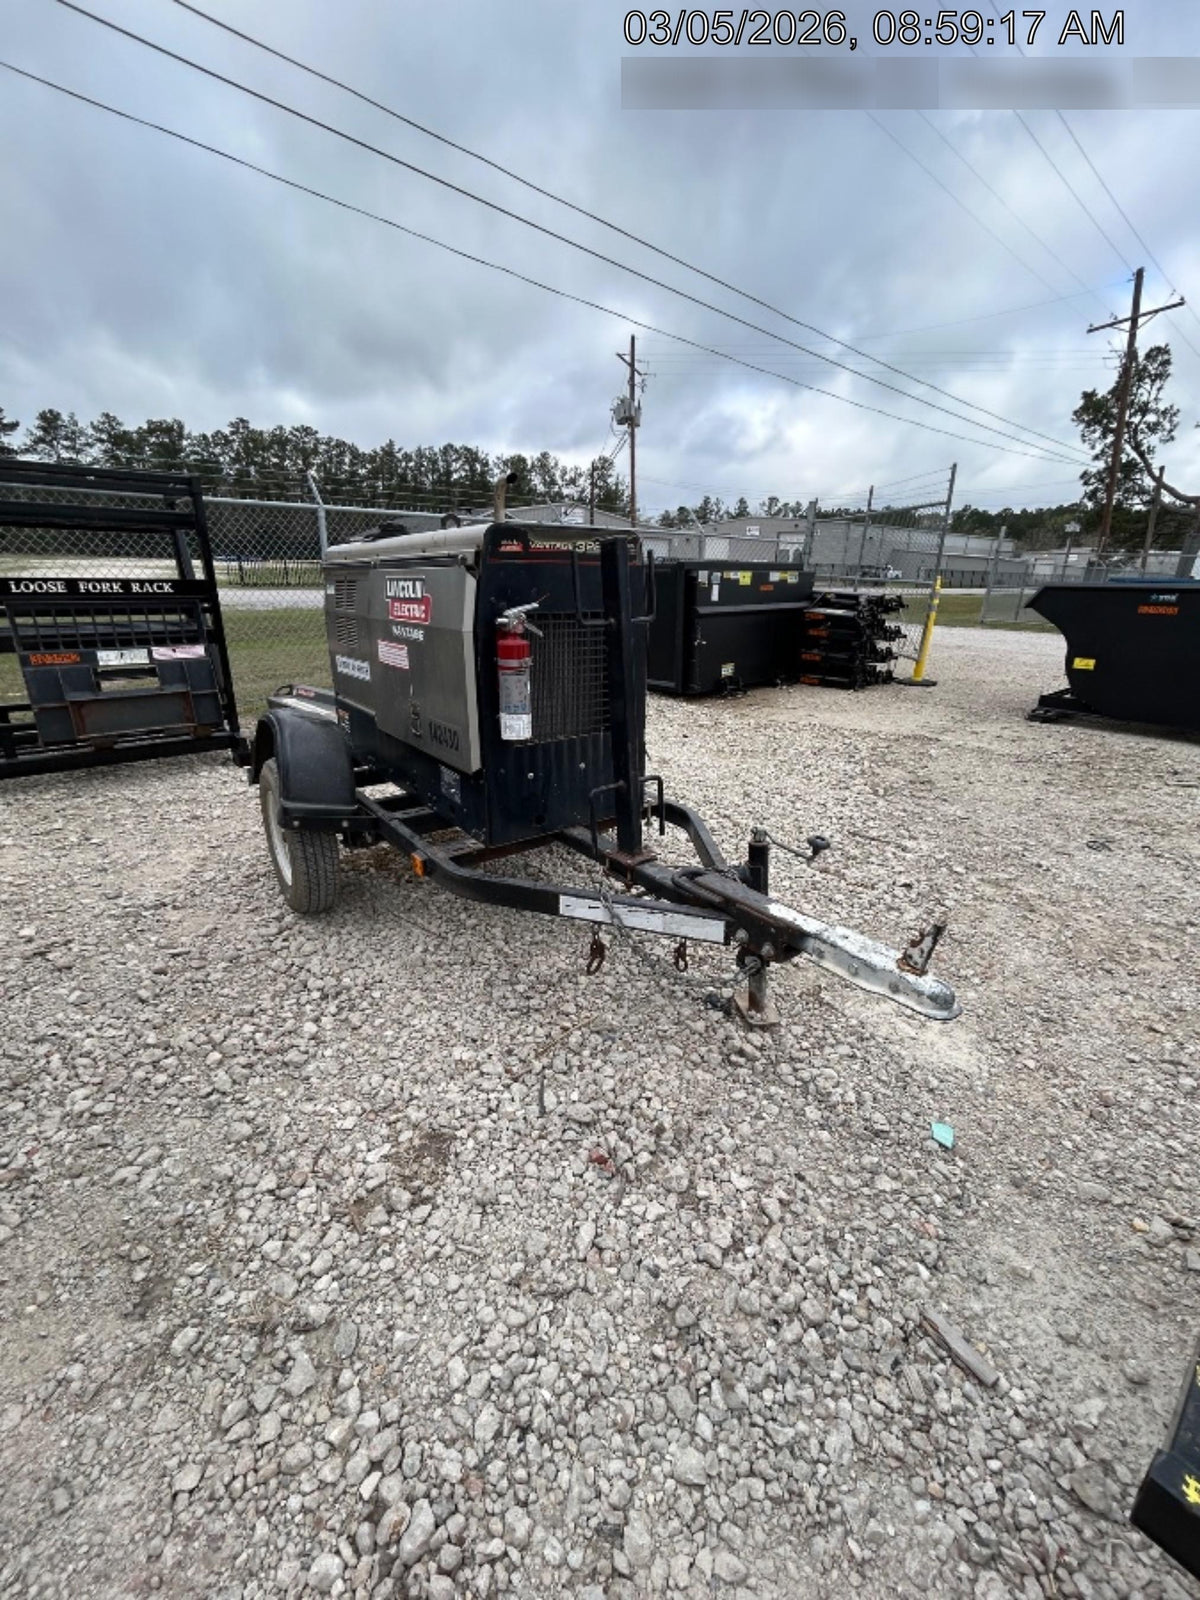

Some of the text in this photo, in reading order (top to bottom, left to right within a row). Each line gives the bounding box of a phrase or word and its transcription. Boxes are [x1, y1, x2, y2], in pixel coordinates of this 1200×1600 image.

[9, 581, 175, 593] LOOSE FORK RACK
[386, 580, 423, 599] LINCOLN
[393, 602, 426, 619] ELECTRIC
